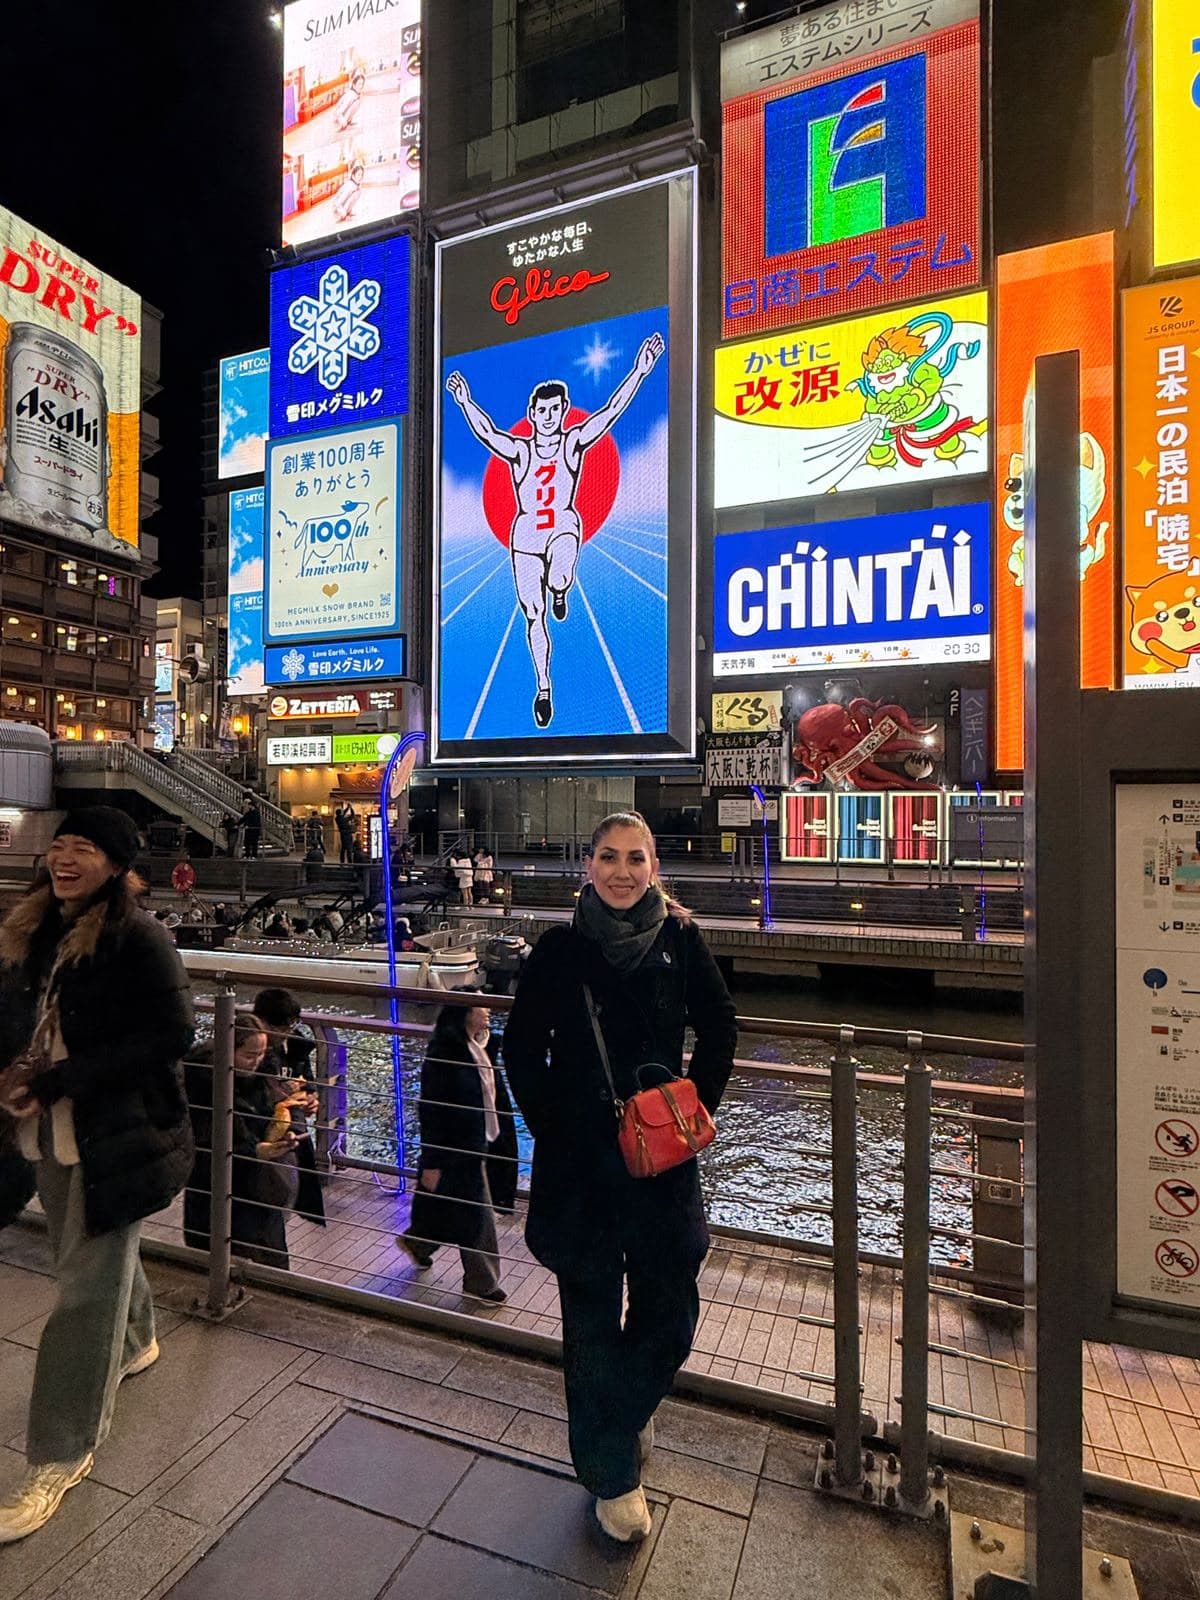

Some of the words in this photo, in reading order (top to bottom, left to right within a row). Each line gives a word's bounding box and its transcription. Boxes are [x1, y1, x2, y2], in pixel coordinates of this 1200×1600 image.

[304, 11, 343, 42] SLIM
[759, 6, 933, 82] エステムシリーズ
[506, 221, 593, 255] すこやかな毎日、
[512, 238, 584, 267] ゆたかな人生
[27, 239, 99, 295] SUPER
[724, 233, 973, 320] 日商エステム
[490, 267, 610, 325] Glico
[1147, 325, 1159, 335] JS
[1160, 319, 1195, 332] GROUP
[744, 340, 831, 374] かぜに
[45, 364, 76, 384] SUPER
[734, 361, 841, 416] 改源
[16, 386, 98, 448] Asahi
[286, 387, 383, 423] 雪印メグミルク
[49, 433, 71, 456] 生
[282, 439, 385, 475] 創業100周年
[294, 469, 371, 498] ありがとう
[534, 460, 558, 531] グリコ
[310, 518, 369, 544] 100th
[296, 560, 370, 578] Anniversary
[287, 606, 319, 616] MEGMILK
[323, 603, 345, 612] SNOW
[347, 600, 374, 610] BRAND
[308, 657, 384, 676] 雪印メグミルク
[721, 657, 756, 670] 天気予報
[289, 699, 360, 715] ZETTERIA
[710, 754, 771, 780] 大阪に乾杯
